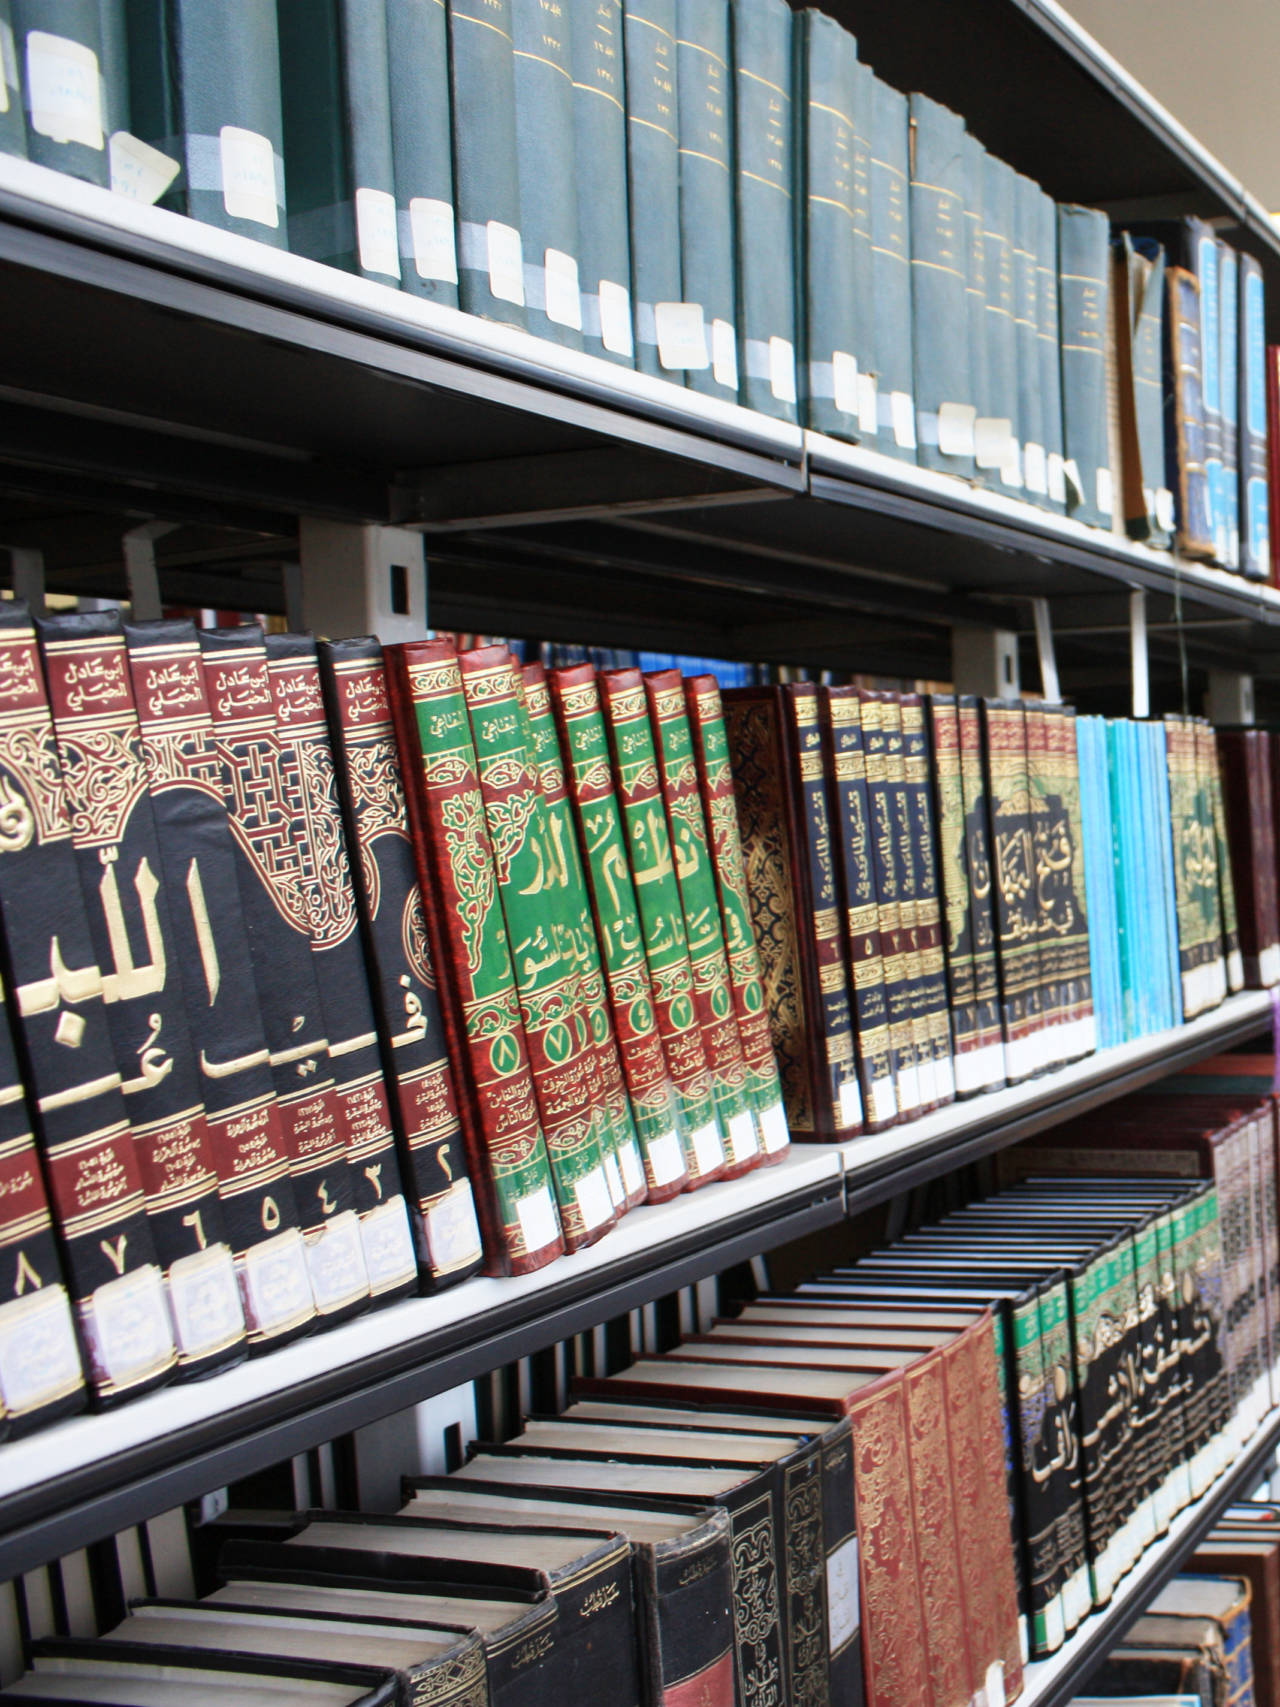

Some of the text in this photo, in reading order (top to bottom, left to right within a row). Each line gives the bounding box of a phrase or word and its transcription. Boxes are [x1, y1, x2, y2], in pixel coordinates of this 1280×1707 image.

[499, 1038, 515, 1067] ٨
[550, 1031, 564, 1054] ٧
[364, 1163, 383, 1199] ٣
[436, 1144, 454, 1182] ٢
[261, 1196, 281, 1231] ٥
[316, 1180, 337, 1214] ٤
[183, 1211, 207, 1249] ٦
[102, 1235, 128, 1274] ٧
[15, 1251, 42, 1296] ٨
